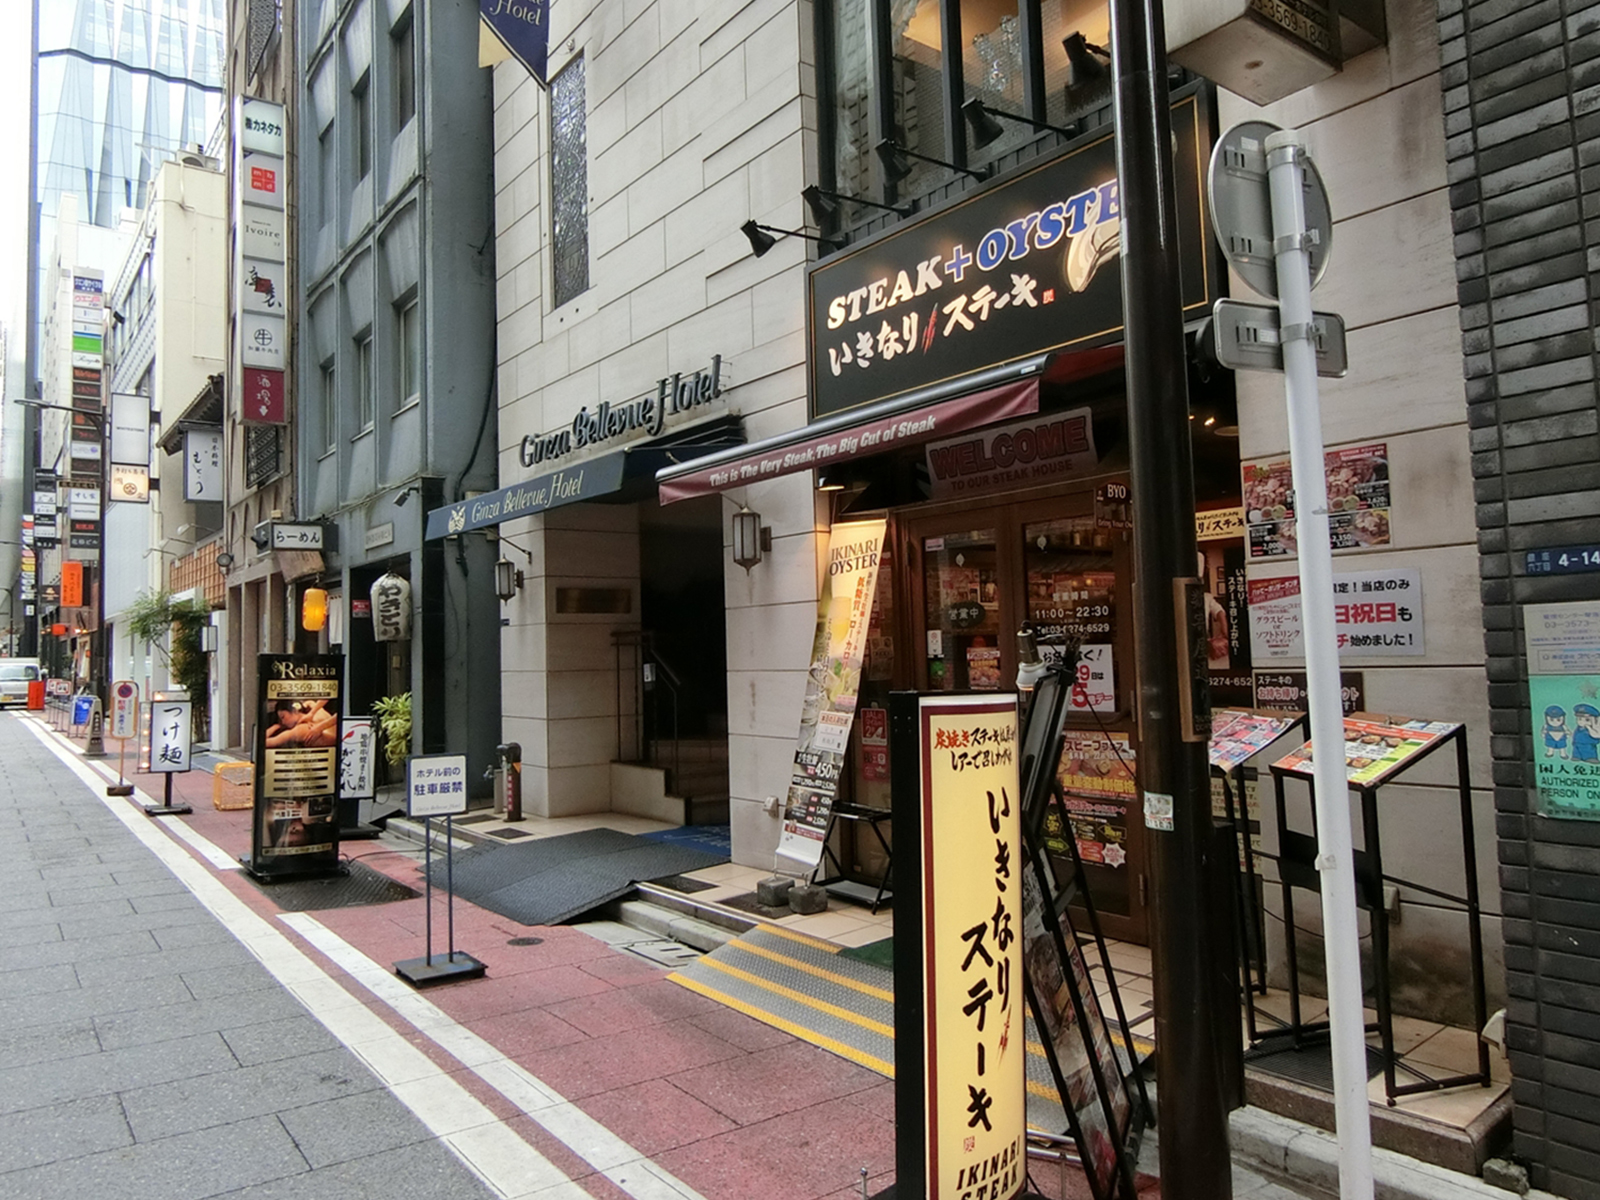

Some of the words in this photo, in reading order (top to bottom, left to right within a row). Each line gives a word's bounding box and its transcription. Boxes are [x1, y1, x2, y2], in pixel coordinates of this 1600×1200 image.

[245, 225, 281, 239] Ivoire
[827, 178, 1121, 330] STEAK+OYSTE
[828, 311, 920, 377] いきなり
[942, 273, 1038, 337] ステーキ
[519, 433, 571, 468] Ginza
[572, 398, 654, 449] Bellevue
[645, 354, 723, 436] Hotel
[709, 470, 729, 487] This
[729, 469, 739, 483] is
[740, 463, 759, 481] The
[760, 457, 782, 479] Very
[783, 449, 816, 469] Steak,
[815, 443, 837, 460] The
[838, 436, 858, 457] Big
[859, 429, 882, 447] Cut
[883, 426, 896, 441] of
[897, 414, 937, 436] Steak
[929, 415, 1090, 481] WELCOME
[951, 479, 965, 491] TO
[967, 474, 990, 488] OUR
[992, 469, 1029, 485] STEAK
[1032, 459, 1073, 478] HOUSE
[471, 498, 501, 524] Ginza
[503, 488, 546, 514] Bellevue
[545, 470, 584, 507] Hotel
[1107, 484, 1127, 499] BYO
[1212, 517, 1245, 532] ステーキ
[276, 531, 321, 544] らーめん
[831, 538, 878, 561] IKINARI
[1558, 550, 1600, 567] 4-14
[829, 553, 878, 576] OYSTER
[1052, 590, 1089, 601] 営業時間
[949, 607, 979, 620] 営業中
[281, 661, 337, 679] Relaxia
[269, 682, 338, 692] 03-3569-1840
[1257, 675, 1293, 685] ステーキの
[158, 706, 184, 765] つけ麺
[416, 767, 461, 778] ホテル前の
[414, 781, 463, 796] 駐車厳禁
[1541, 777, 1599, 788] AUTHORIZED
[1541, 788, 1579, 799] PERSON
[985, 786, 1015, 1014] いきなり
[960, 920, 994, 1133] ステーキ
[956, 1134, 1020, 1191] IKINARI
